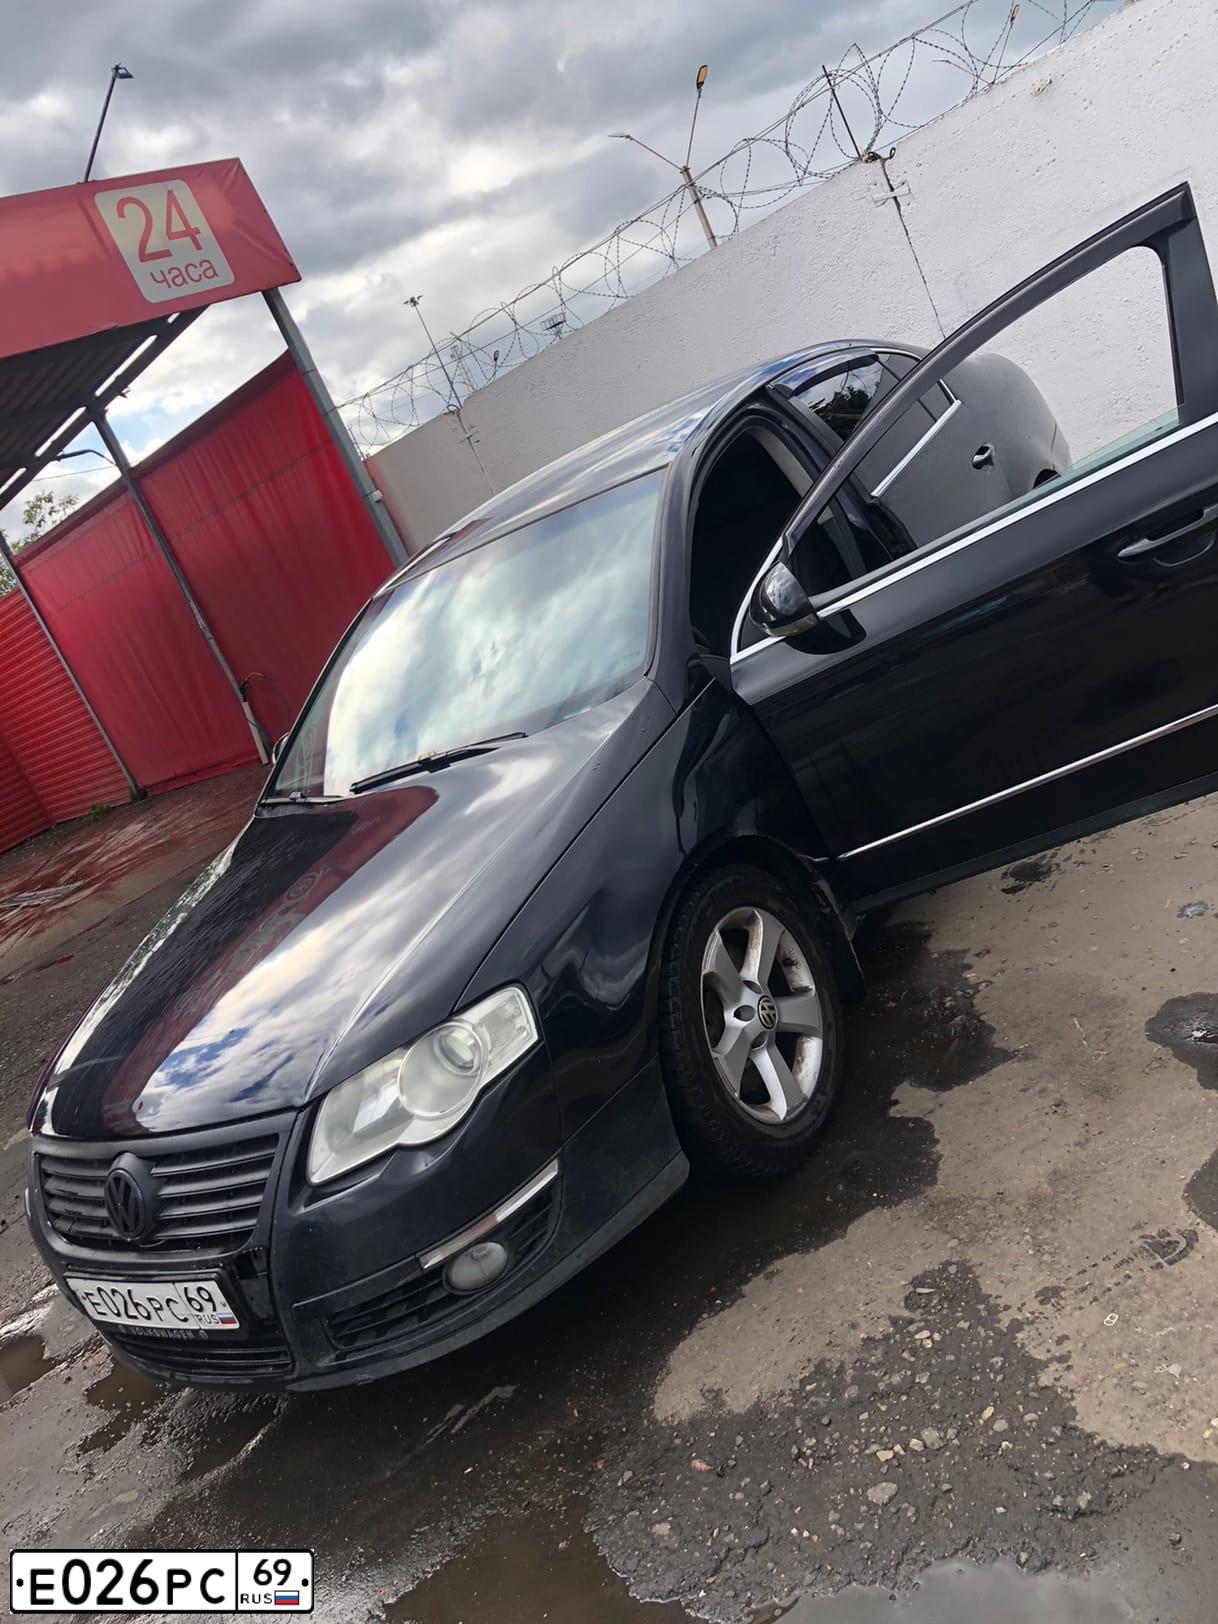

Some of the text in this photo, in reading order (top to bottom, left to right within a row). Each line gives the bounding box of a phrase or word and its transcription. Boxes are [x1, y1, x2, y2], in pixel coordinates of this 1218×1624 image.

[116, 190, 202, 263] 24
[150, 259, 219, 288] часа
[184, 1286, 217, 1312] 69
[197, 1314, 219, 1325] RUS
